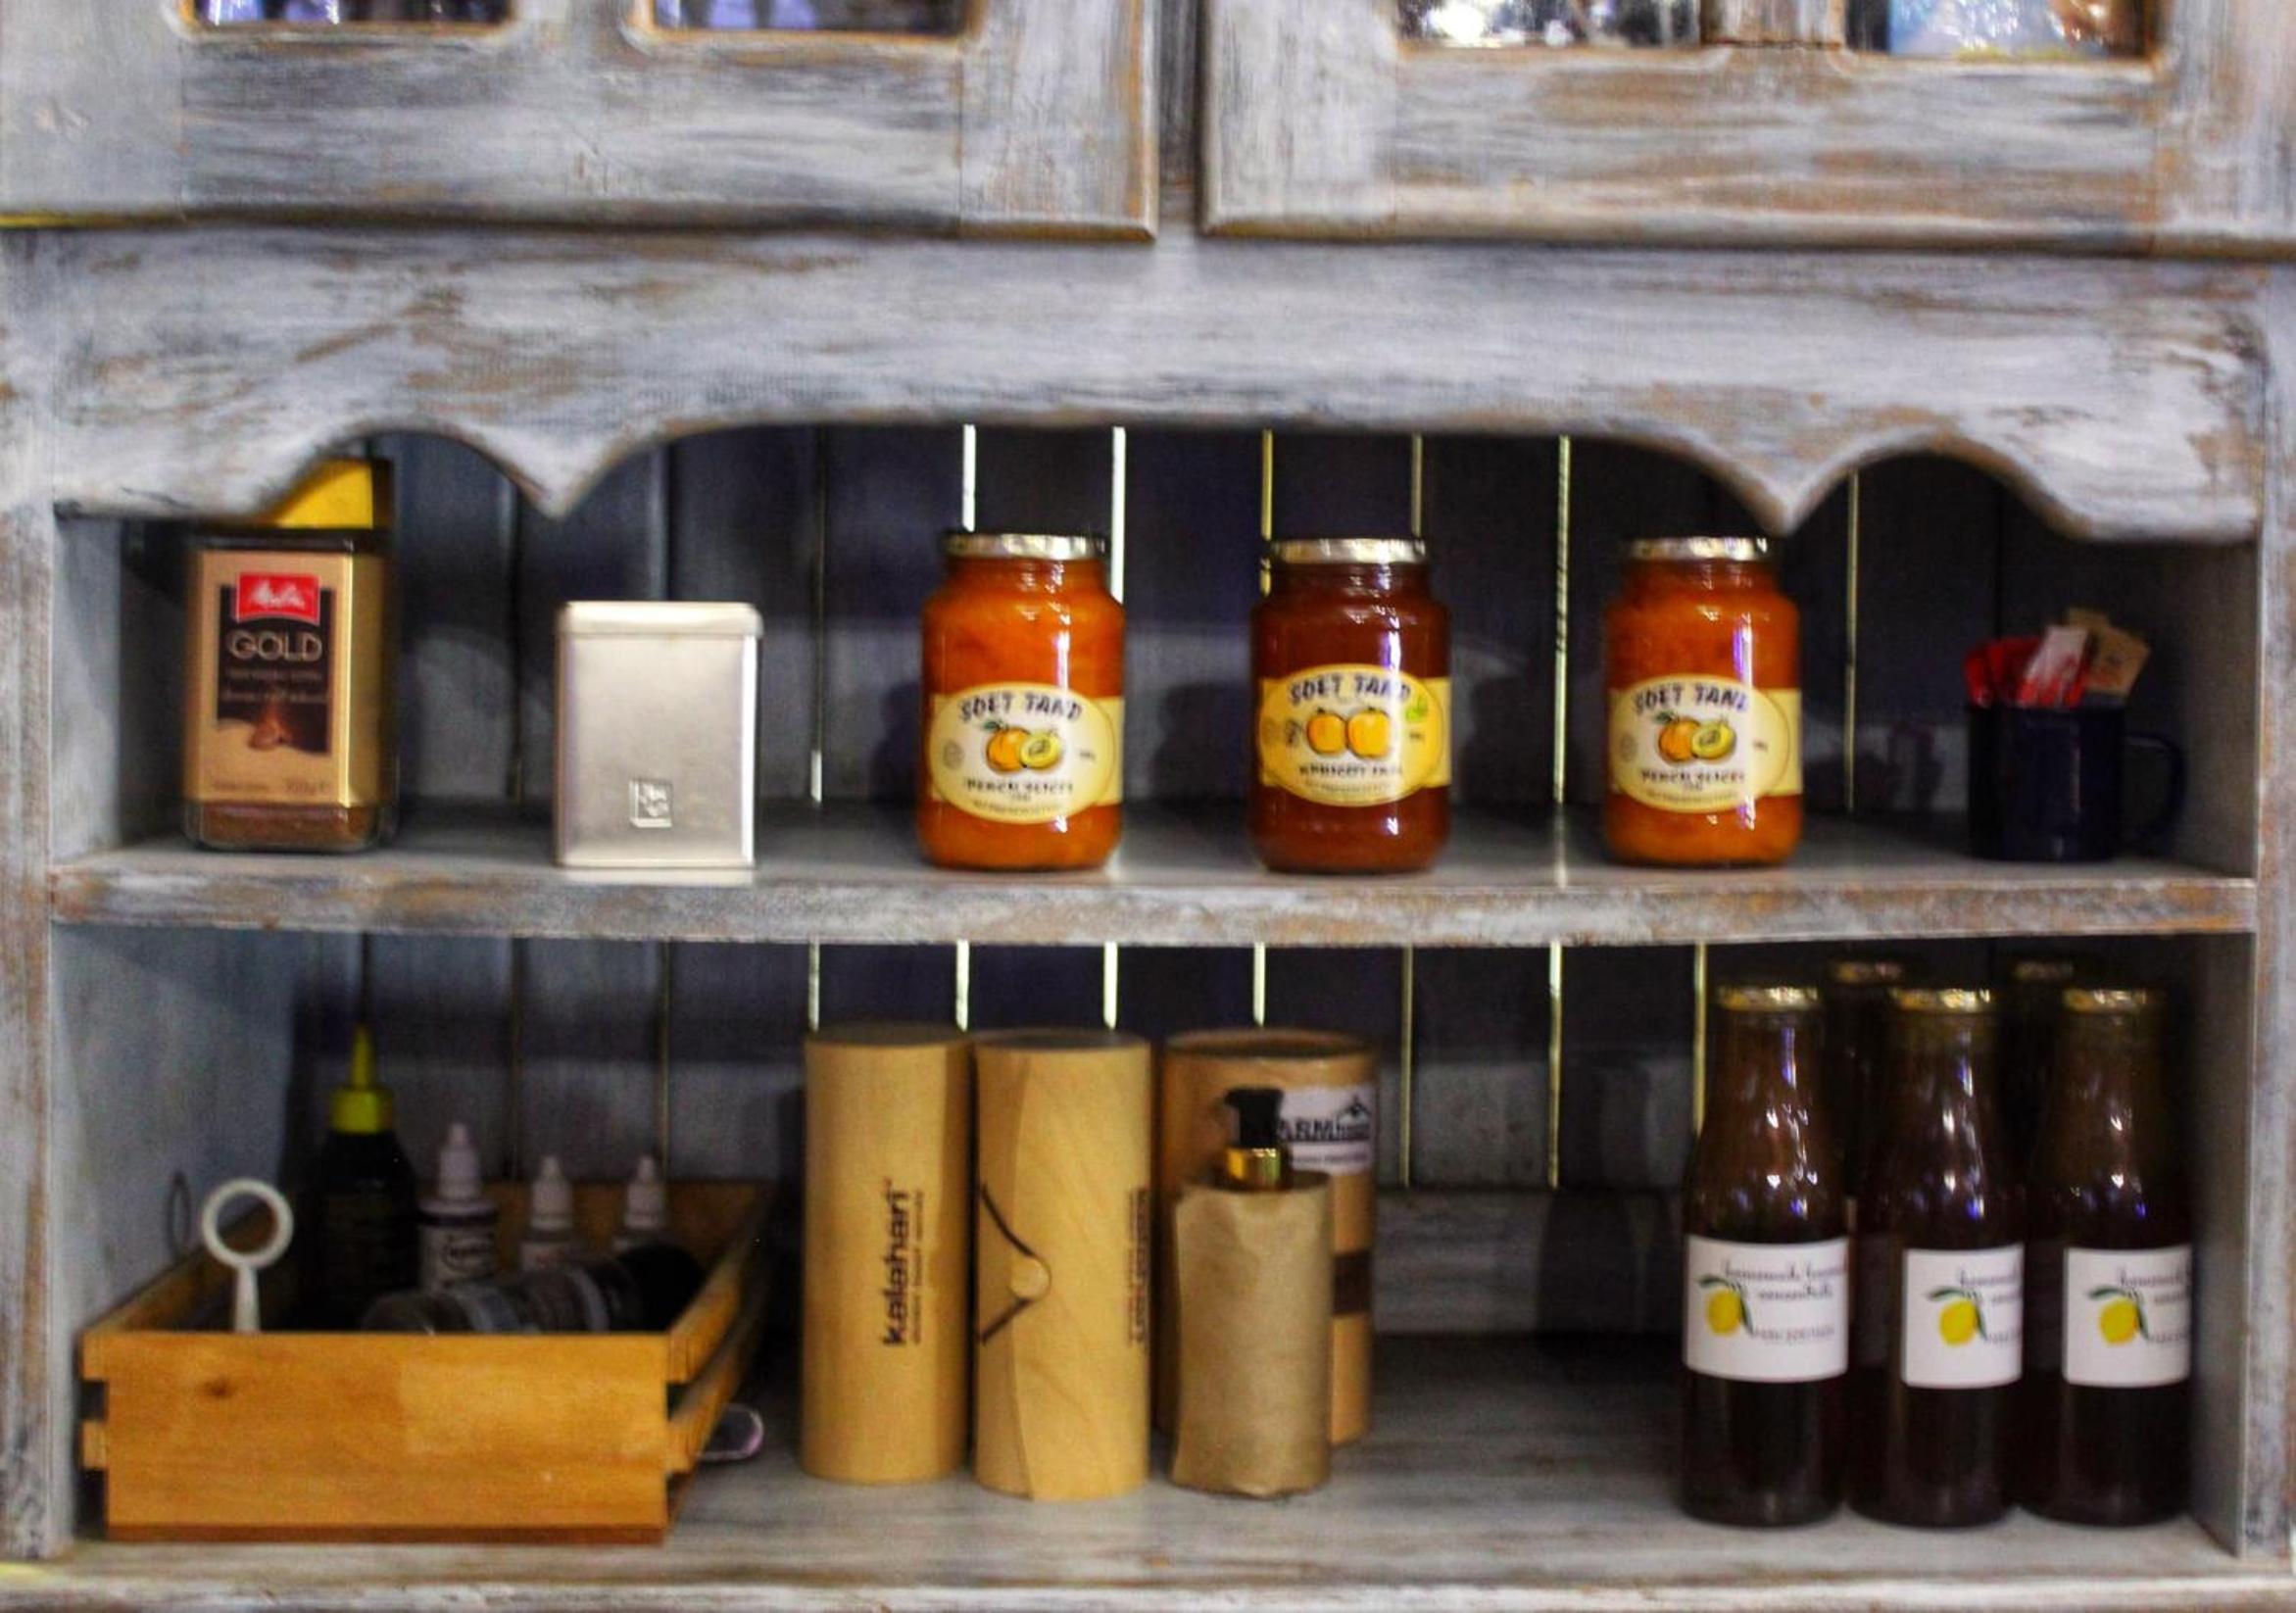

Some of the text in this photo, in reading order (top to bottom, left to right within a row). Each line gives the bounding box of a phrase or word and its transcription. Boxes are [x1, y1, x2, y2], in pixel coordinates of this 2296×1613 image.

[228, 630, 324, 662] GOLD
[960, 693, 1015, 722] SOET
[883, 1177, 909, 1346] kalahari
